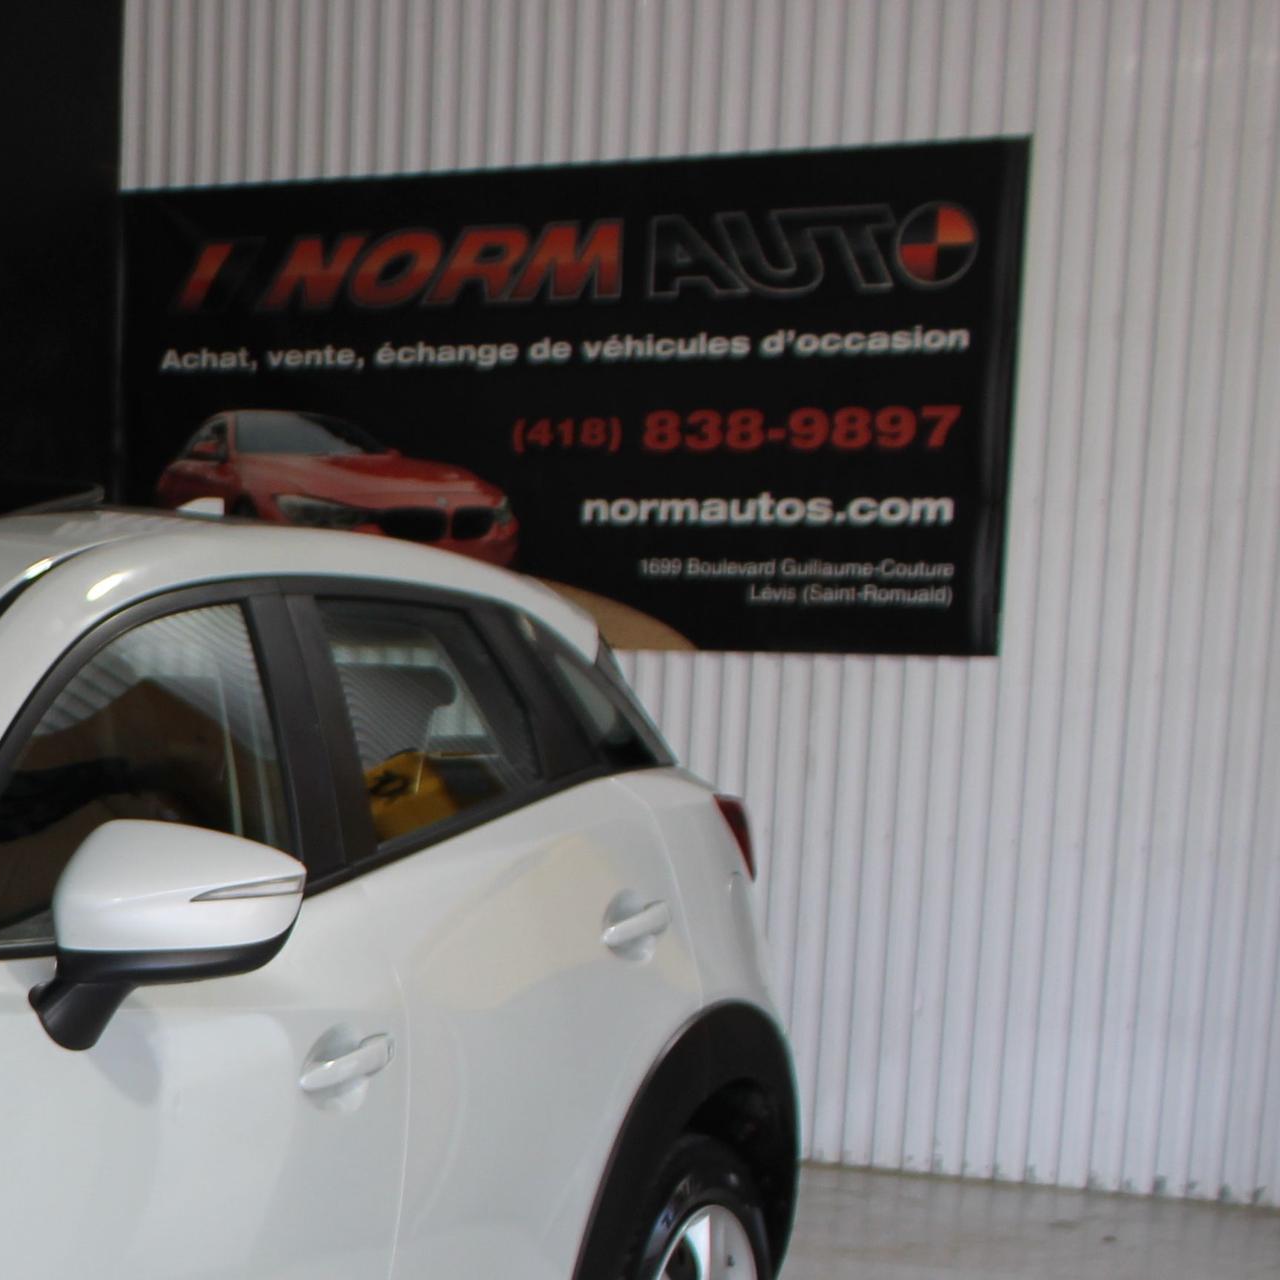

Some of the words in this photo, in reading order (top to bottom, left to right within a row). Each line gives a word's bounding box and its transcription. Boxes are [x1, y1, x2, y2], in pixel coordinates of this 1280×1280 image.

[255, 218, 624, 310] NORM
[647, 201, 978, 297] AUTO
[160, 347, 258, 372] Achat,
[268, 344, 366, 370] vente,
[375, 341, 519, 371] échange
[530, 336, 572, 361] de
[582, 331, 751, 360] véhicules
[759, 325, 971, 355] d'occasion
[511, 416, 623, 453] (418)
[642, 404, 963, 453] 838-9897
[580, 491, 955, 526] normautos.com
[640, 557, 683, 576] 1699
[687, 557, 776, 577] Boulevard
[781, 558, 955, 578] Guillaume-Couture
[750, 584, 797, 602] Lévis
[803, 584, 954, 607] (Saint-Romuald)
